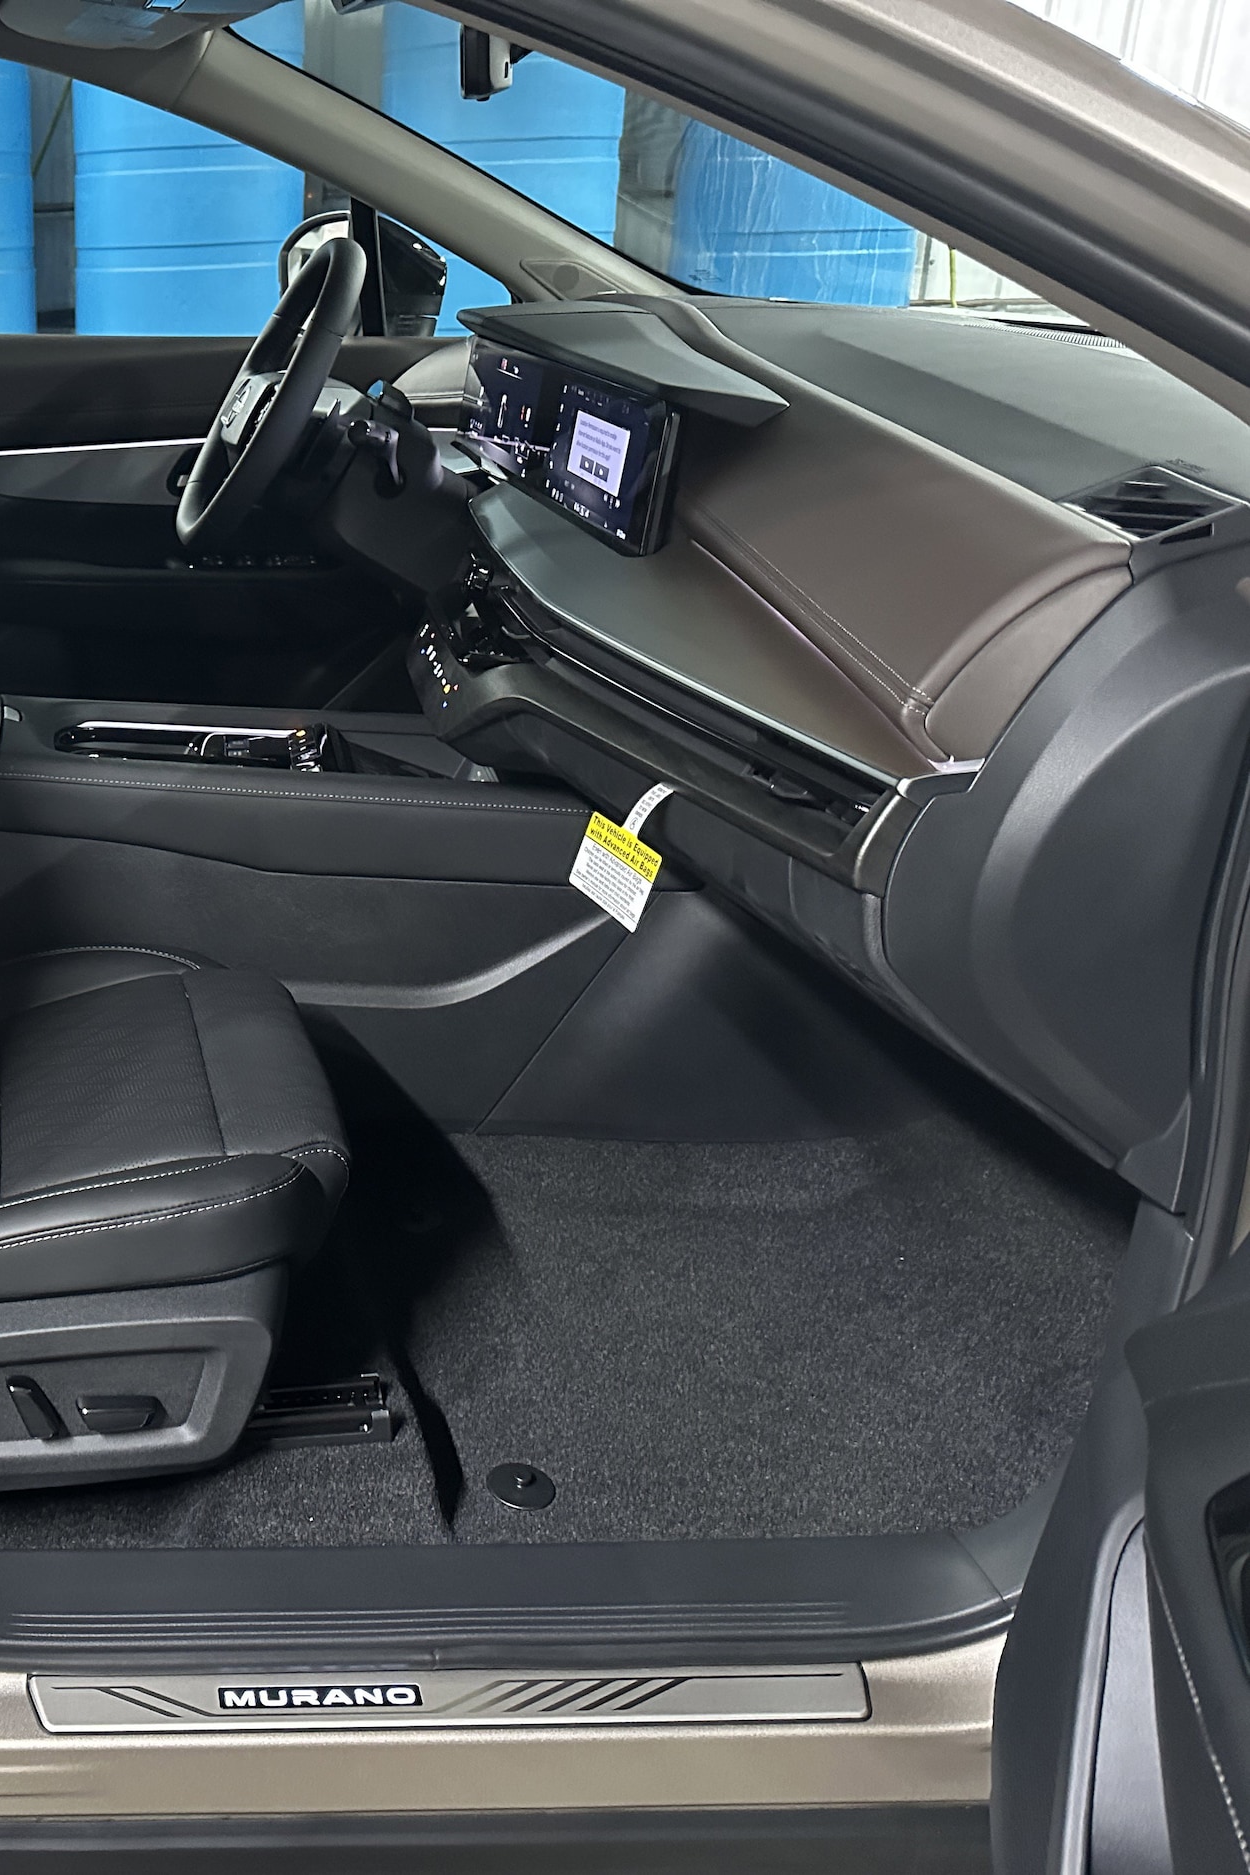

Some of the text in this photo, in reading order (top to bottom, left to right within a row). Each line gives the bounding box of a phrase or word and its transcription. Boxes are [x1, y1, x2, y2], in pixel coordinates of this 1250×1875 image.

[591, 829, 653, 878] with Advanced Air Bags
[593, 816, 605, 829] This
[606, 825, 626, 843] Vehicle
[633, 843, 658, 868] Equipped
[223, 1687, 417, 1707] MURANO
